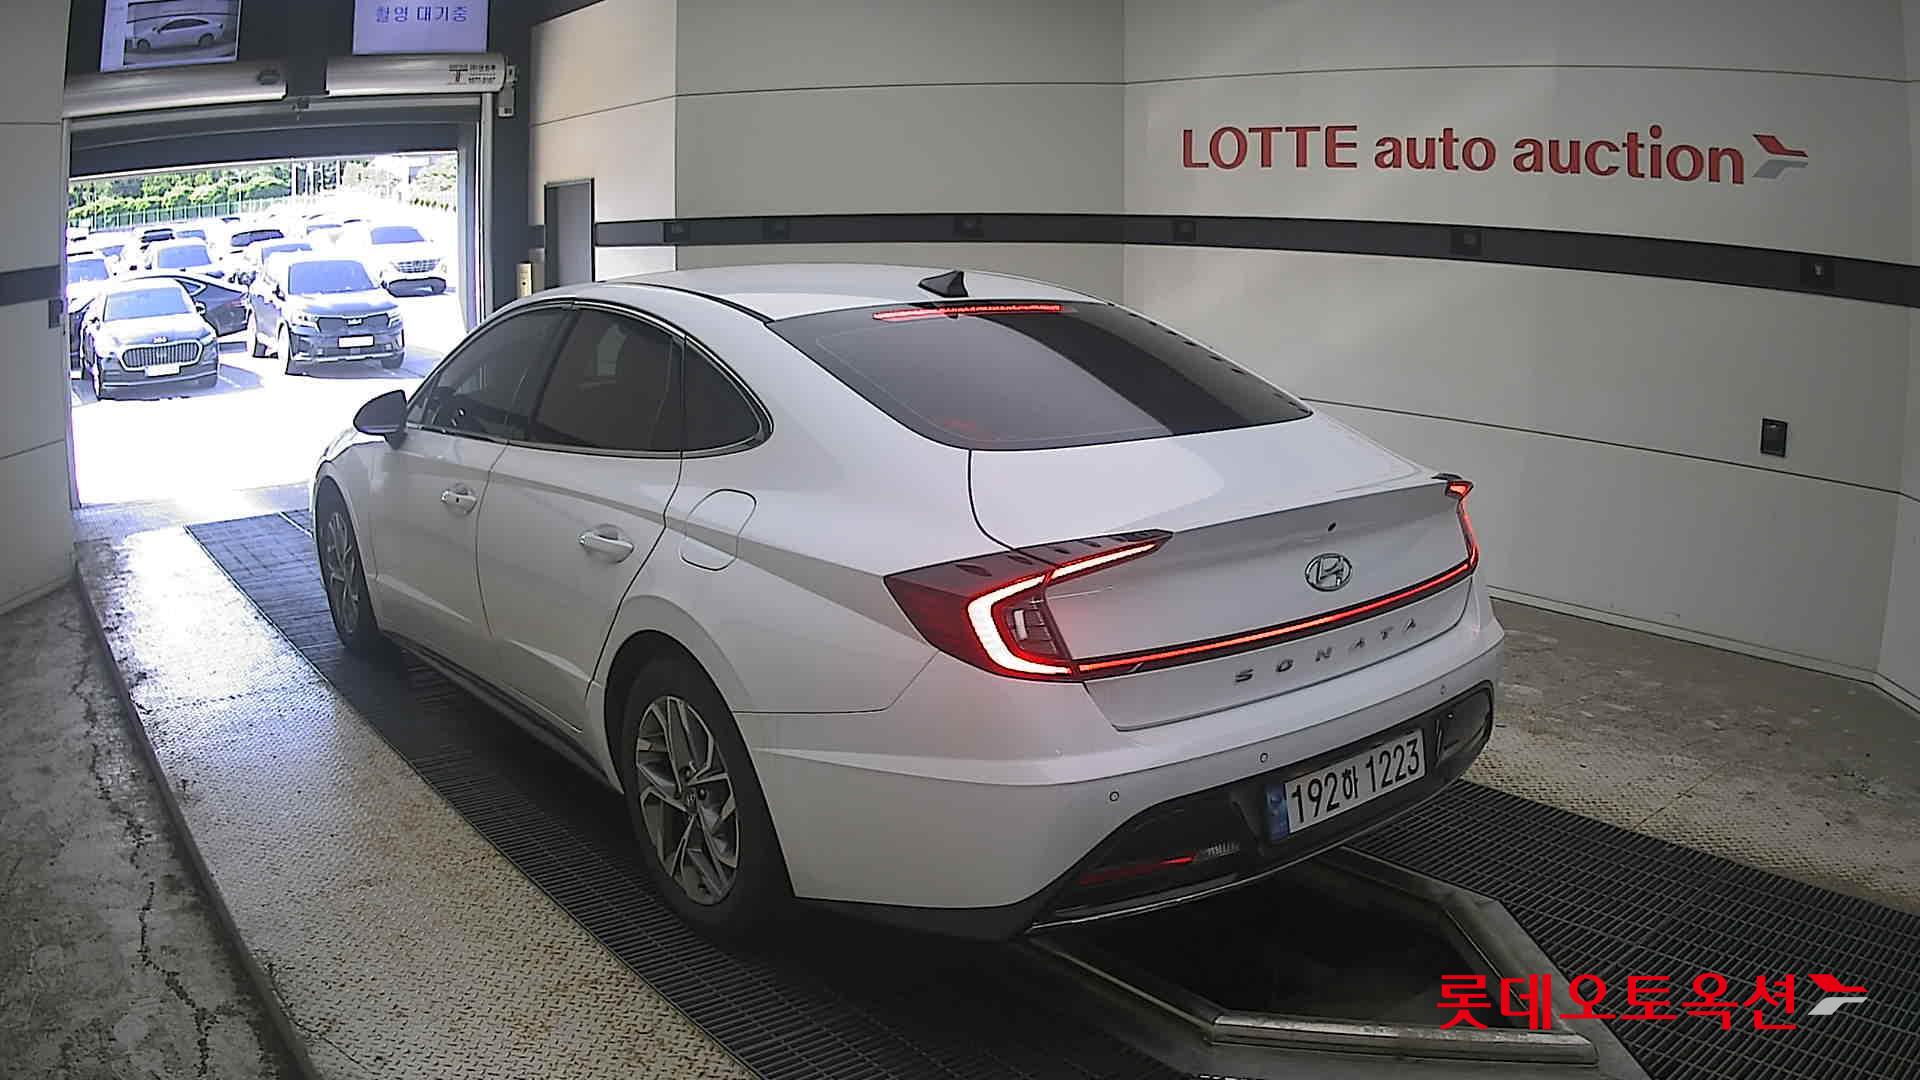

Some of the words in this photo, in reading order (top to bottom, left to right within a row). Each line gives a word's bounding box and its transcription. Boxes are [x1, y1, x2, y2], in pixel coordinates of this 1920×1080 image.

[416, 6, 467, 22] 대기중
[1183, 125, 1358, 168] LOTTE
[1375, 128, 1496, 171] auto
[1513, 125, 1745, 184] auction
[1234, 618, 1417, 684] SONATA
[1291, 766, 1359, 823] 192하
[1366, 741, 1421, 793] 1223
